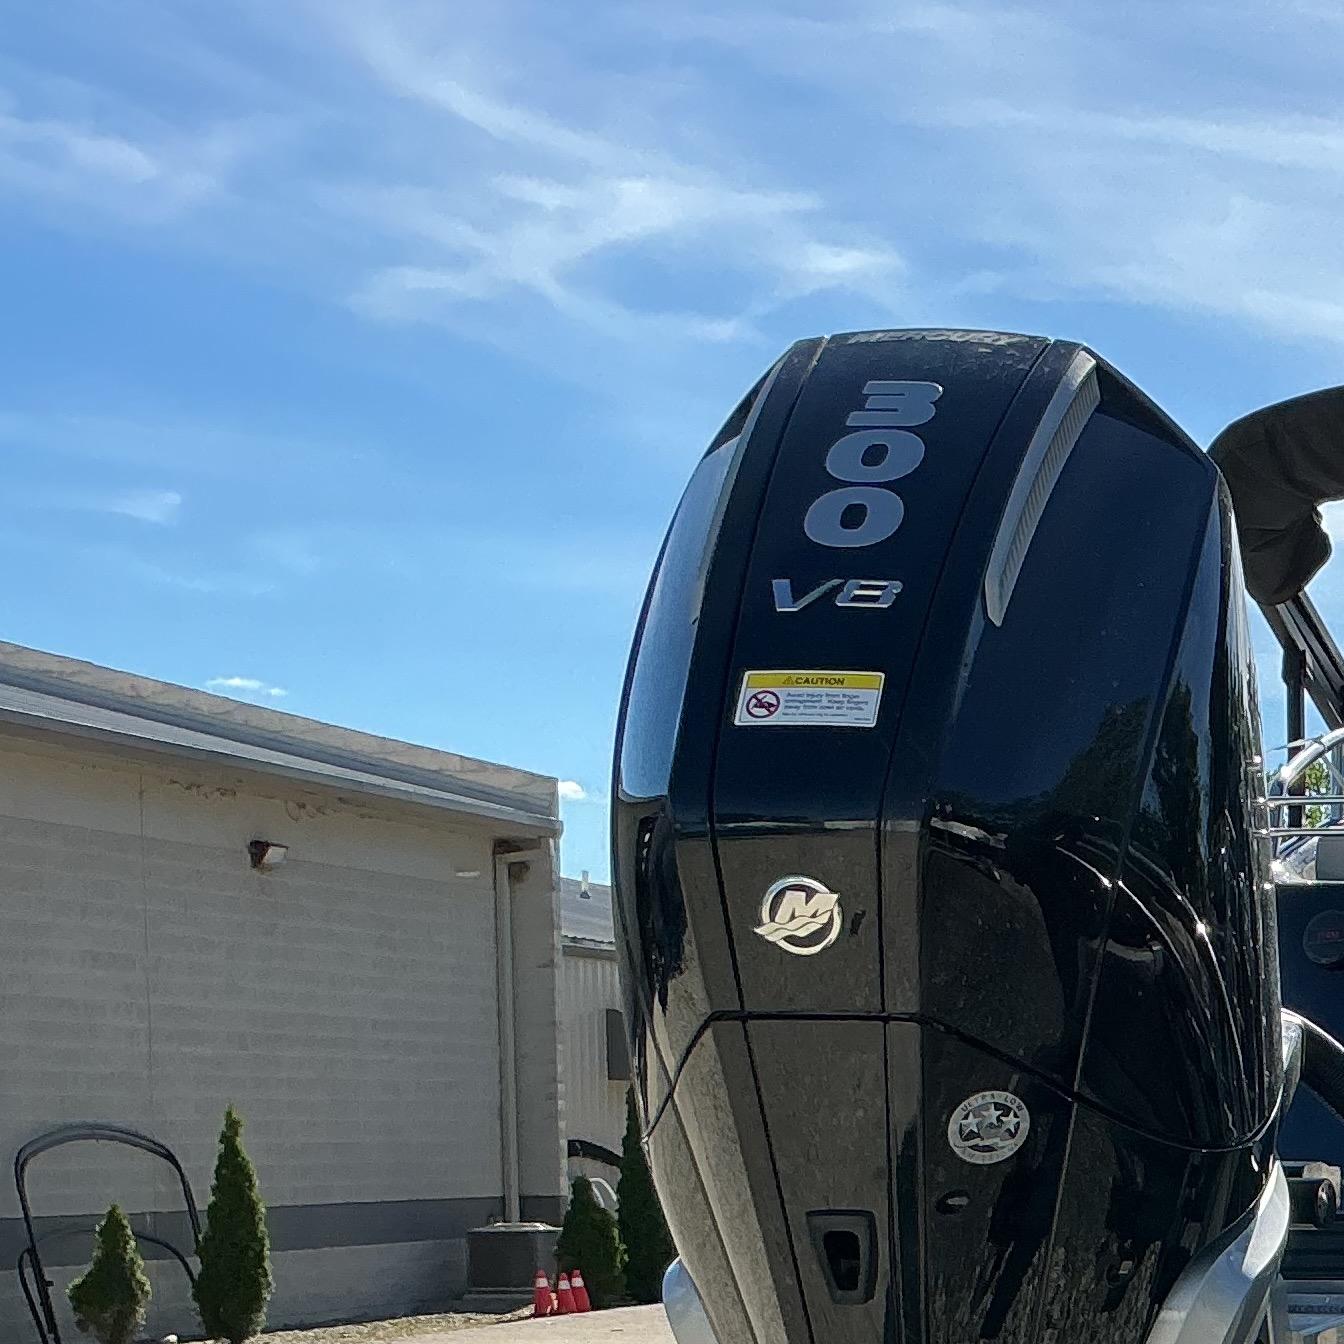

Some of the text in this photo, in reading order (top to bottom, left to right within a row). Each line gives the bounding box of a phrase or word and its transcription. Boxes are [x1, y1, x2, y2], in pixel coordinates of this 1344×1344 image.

[804, 380, 944, 548] 300
[771, 578, 904, 612] V8
[794, 676, 846, 686] CAUTION
